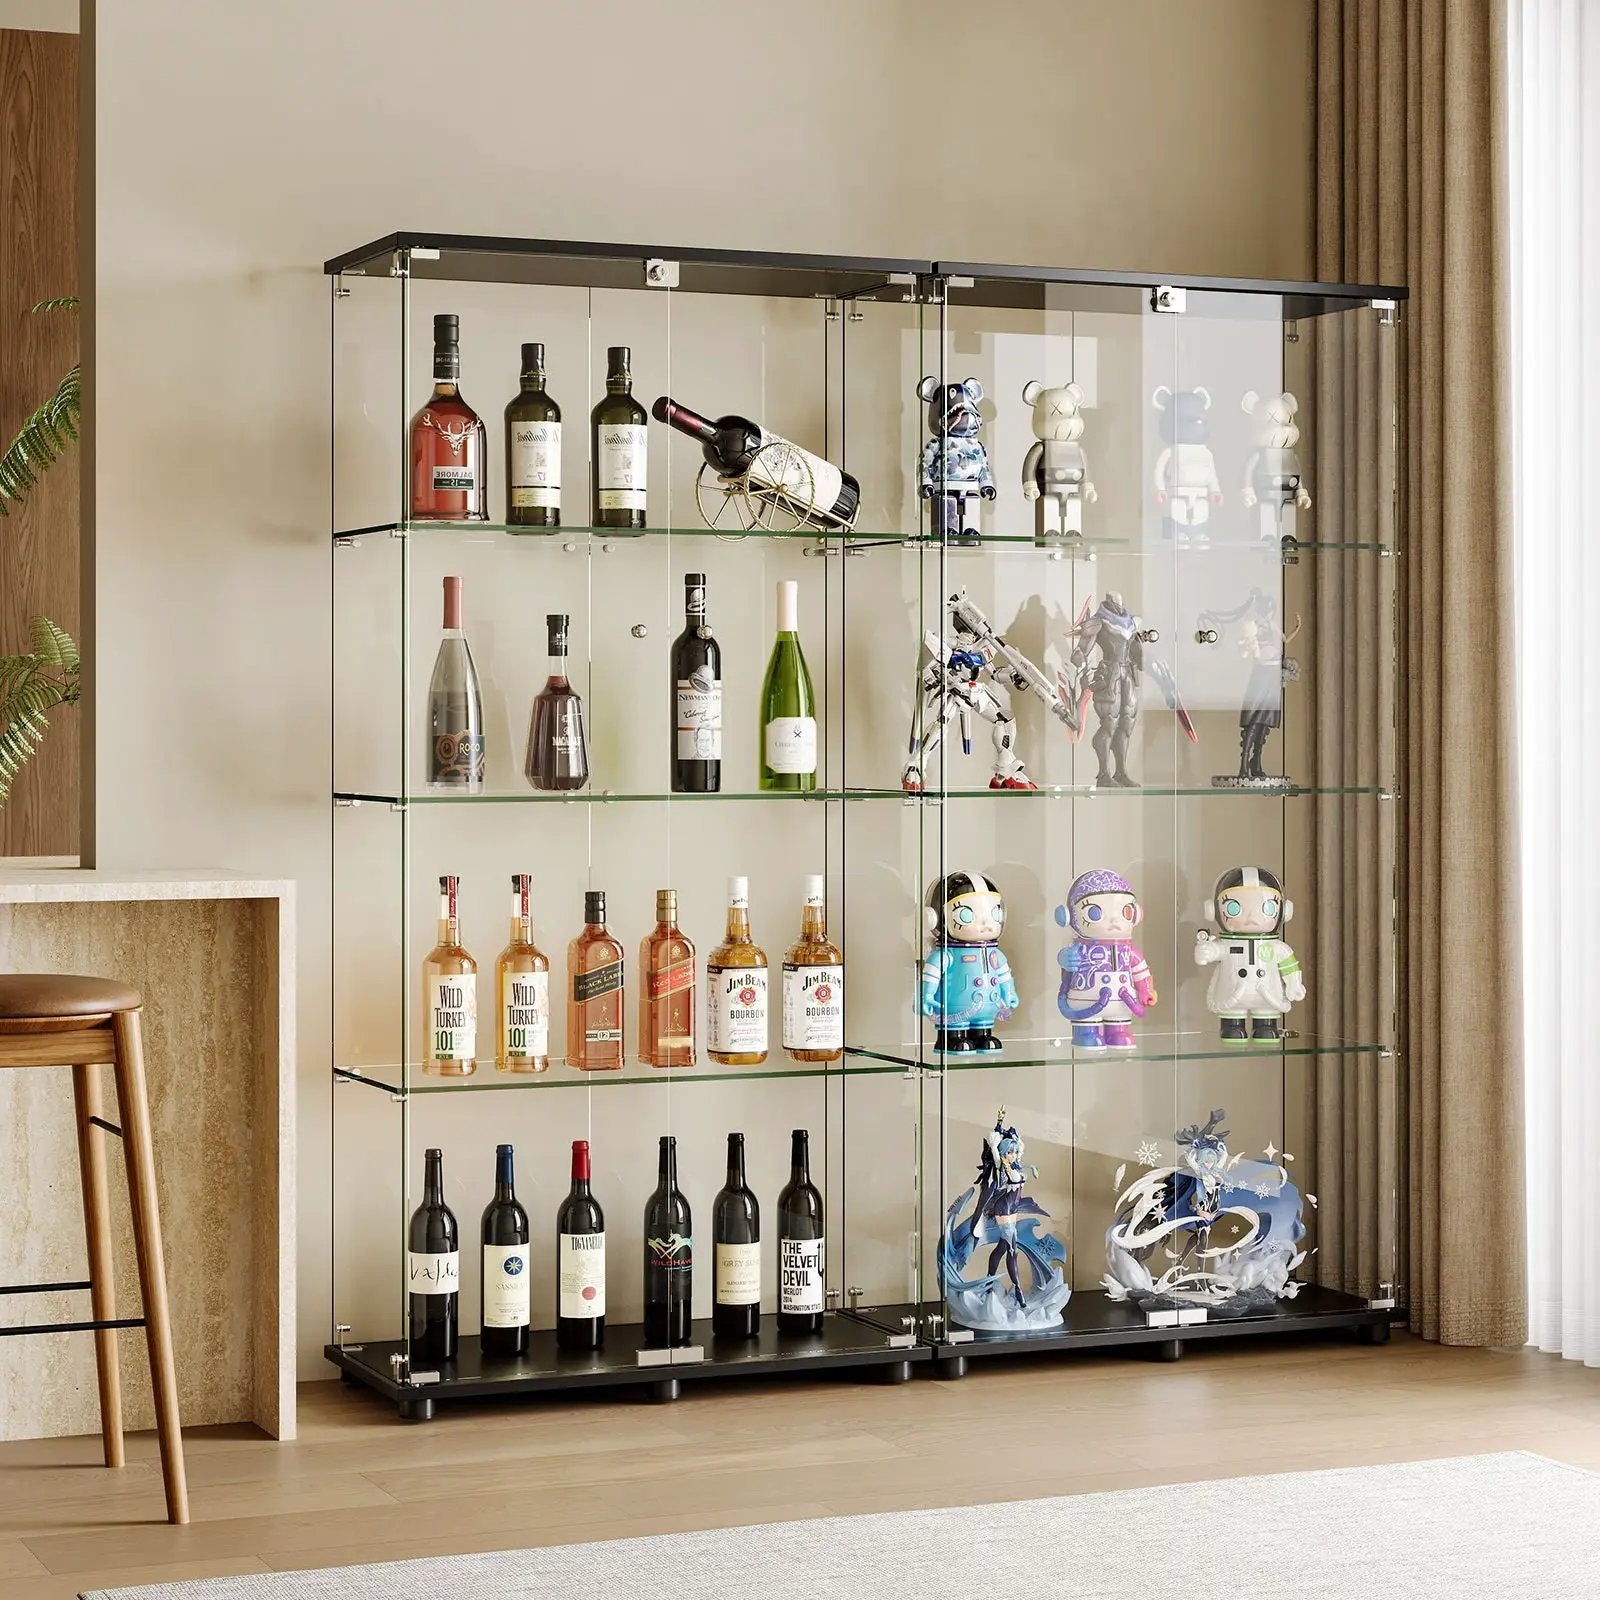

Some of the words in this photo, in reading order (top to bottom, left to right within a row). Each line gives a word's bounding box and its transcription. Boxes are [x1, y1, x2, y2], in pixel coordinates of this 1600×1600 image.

[726, 978, 743, 993] JIM
[802, 975, 819, 991] JIM
[439, 985, 463, 1009] WILD
[512, 982, 536, 1006] WILD
[434, 1007, 466, 1028] TURKEY
[507, 1005, 539, 1026] TURKEY
[730, 1009, 764, 1019] BOURBON
[806, 1006, 840, 1017] BOURBON
[435, 1030, 454, 1051] 101
[508, 1027, 527, 1048] 101
[783, 1241, 802, 1254] THE
[783, 1255, 818, 1268] VELVET
[783, 1270, 811, 1286] DEVIL
[783, 1287, 802, 1295] MERLOT
